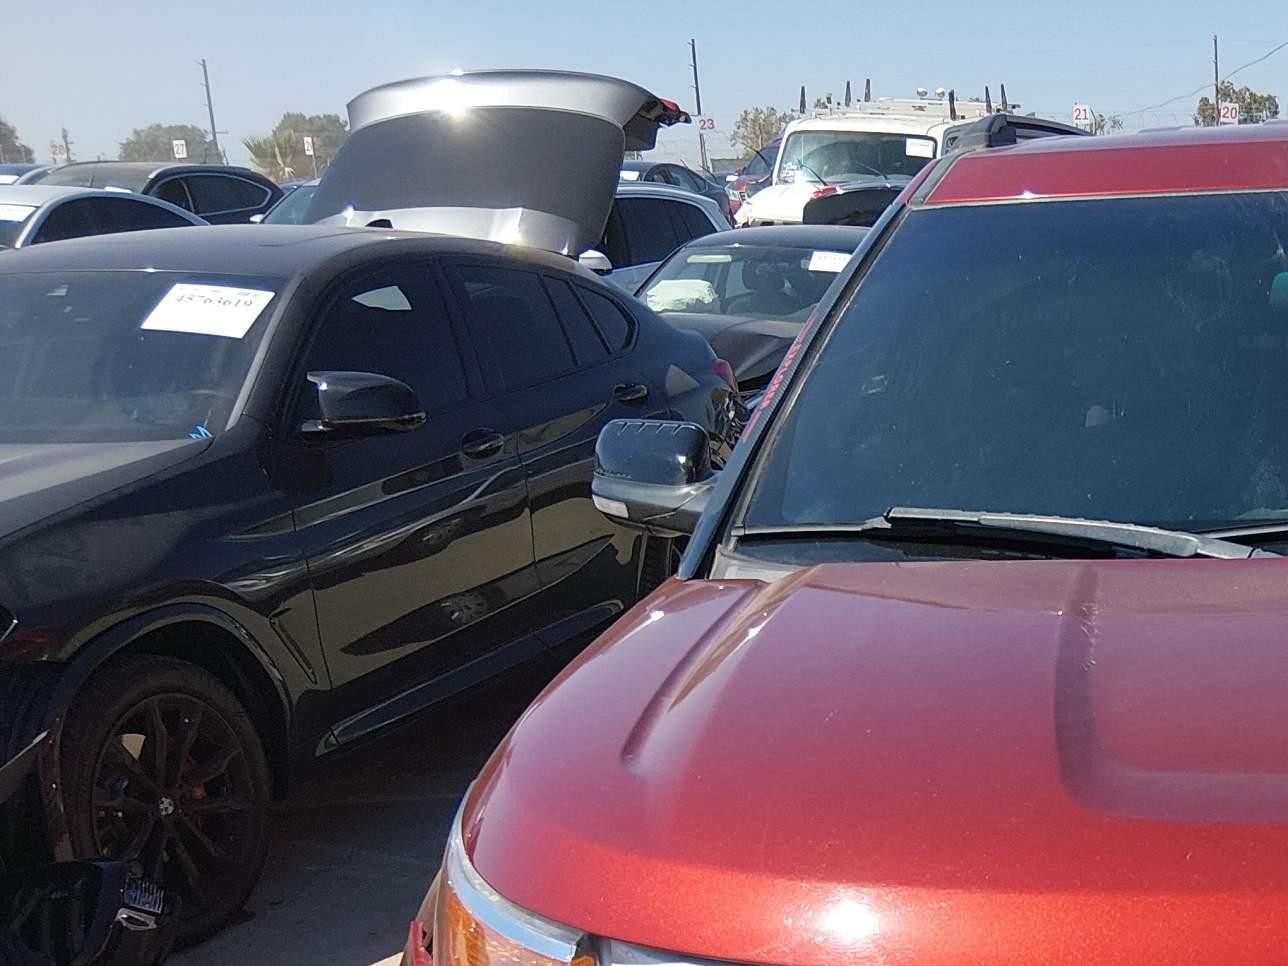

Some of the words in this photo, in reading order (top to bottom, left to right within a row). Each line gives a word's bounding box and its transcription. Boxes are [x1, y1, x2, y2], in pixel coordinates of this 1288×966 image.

[1074, 108, 1089, 121] 21
[1221, 106, 1238, 120] 20
[699, 118, 715, 130] 23
[175, 144, 185, 155] 27
